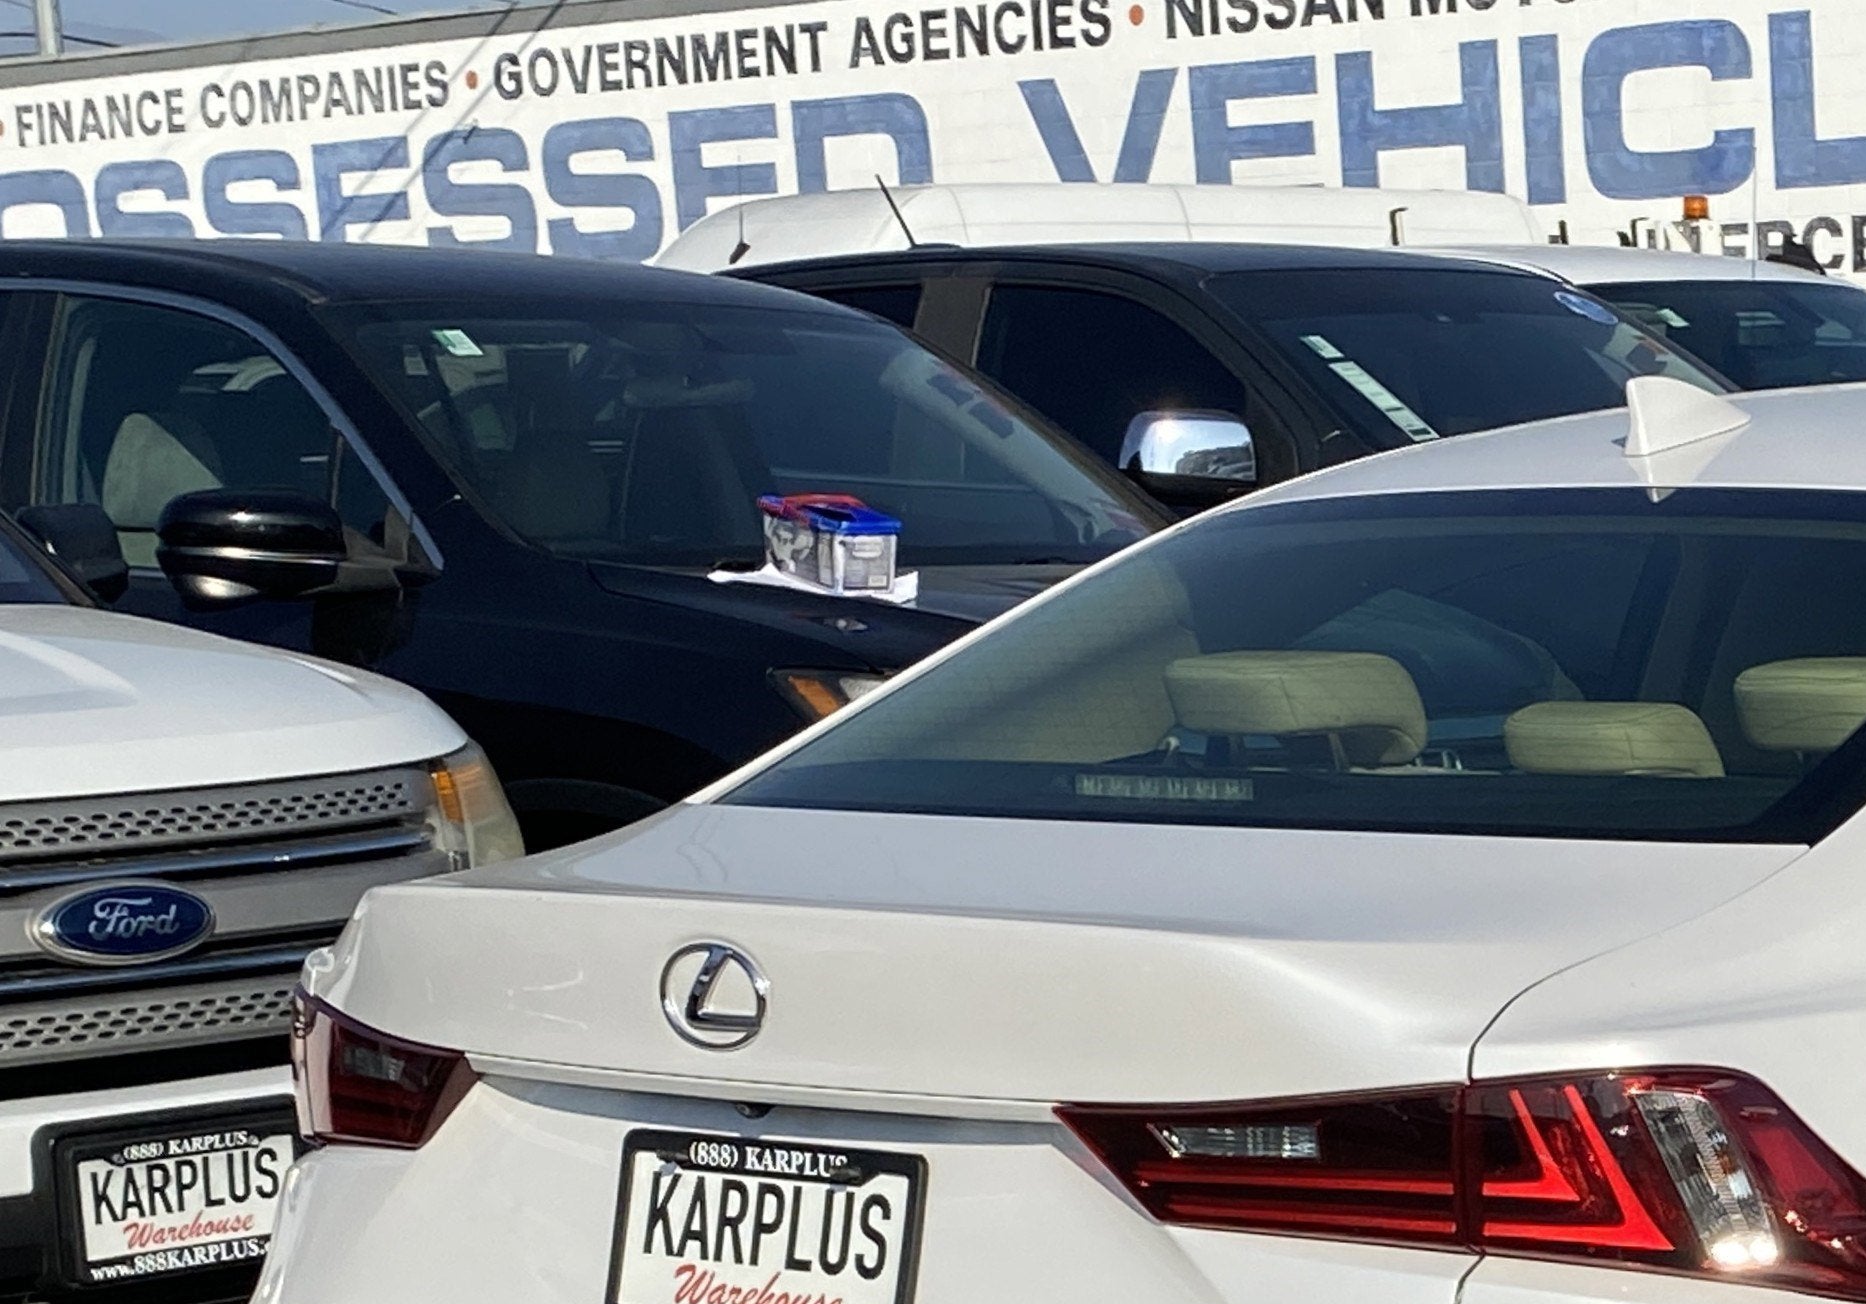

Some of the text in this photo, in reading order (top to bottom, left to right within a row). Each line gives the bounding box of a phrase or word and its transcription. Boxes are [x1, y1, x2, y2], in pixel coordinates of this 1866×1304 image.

[15, 87, 188, 148] FINANCE
[200, 60, 449, 130] COMPANIES
[492, 21, 828, 101] GOVERNMENT
[849, 0, 1112, 68] AGENCIES
[88, 898, 180, 940] Ford
[123, 1131, 248, 1161] (888) KARPLUS
[689, 1142, 738, 1168] (888)
[90, 1147, 280, 1225] KARPLUS
[123, 1210, 255, 1250] Warehouse
[643, 1171, 892, 1281] KARPLUS
